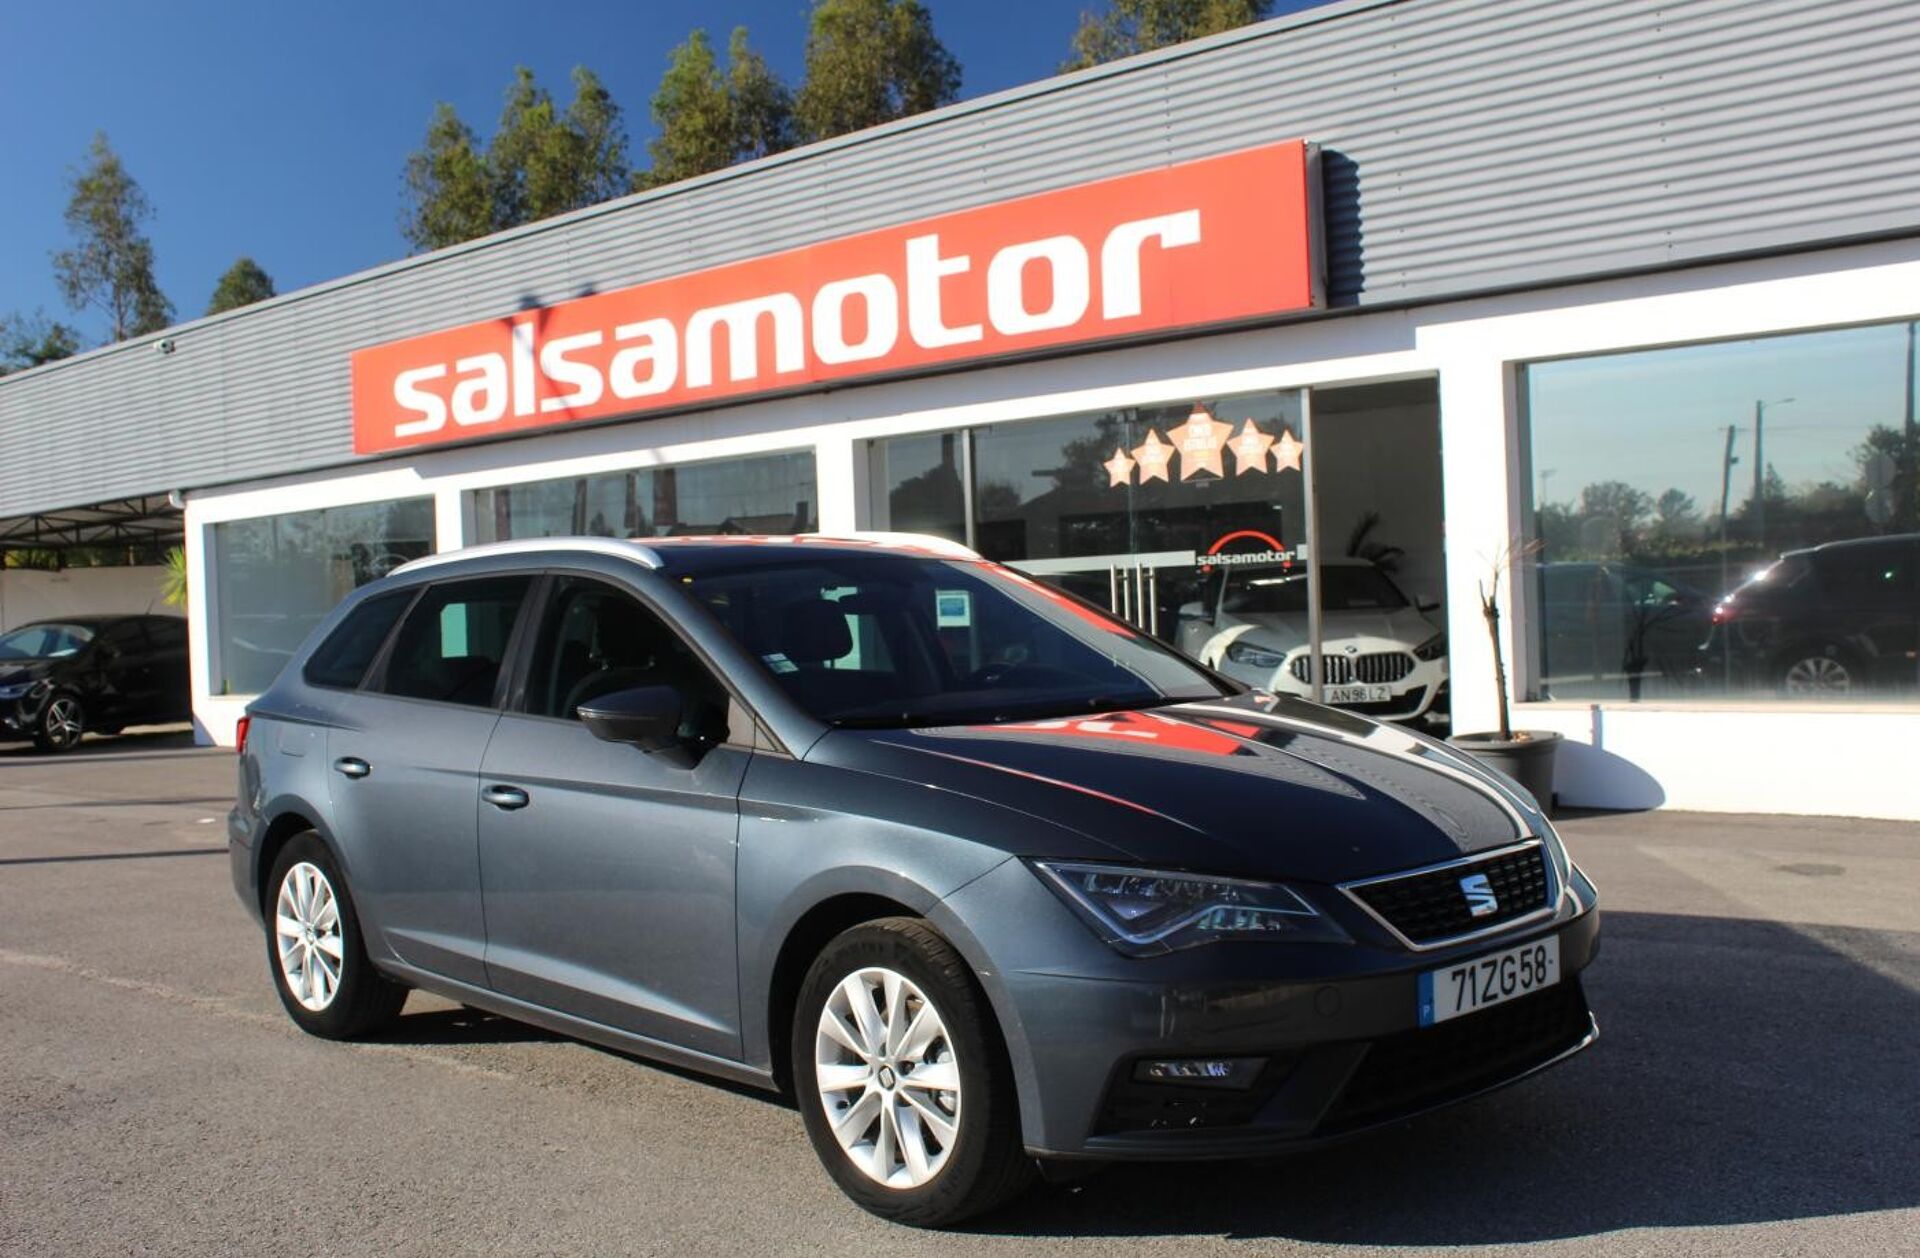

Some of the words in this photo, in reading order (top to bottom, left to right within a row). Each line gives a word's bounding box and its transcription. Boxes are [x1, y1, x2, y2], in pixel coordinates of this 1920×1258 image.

[393, 209, 1201, 438] salsamotor
[1196, 549, 1296, 565] salsamotor
[1451, 945, 1547, 1012] 71ZG58
